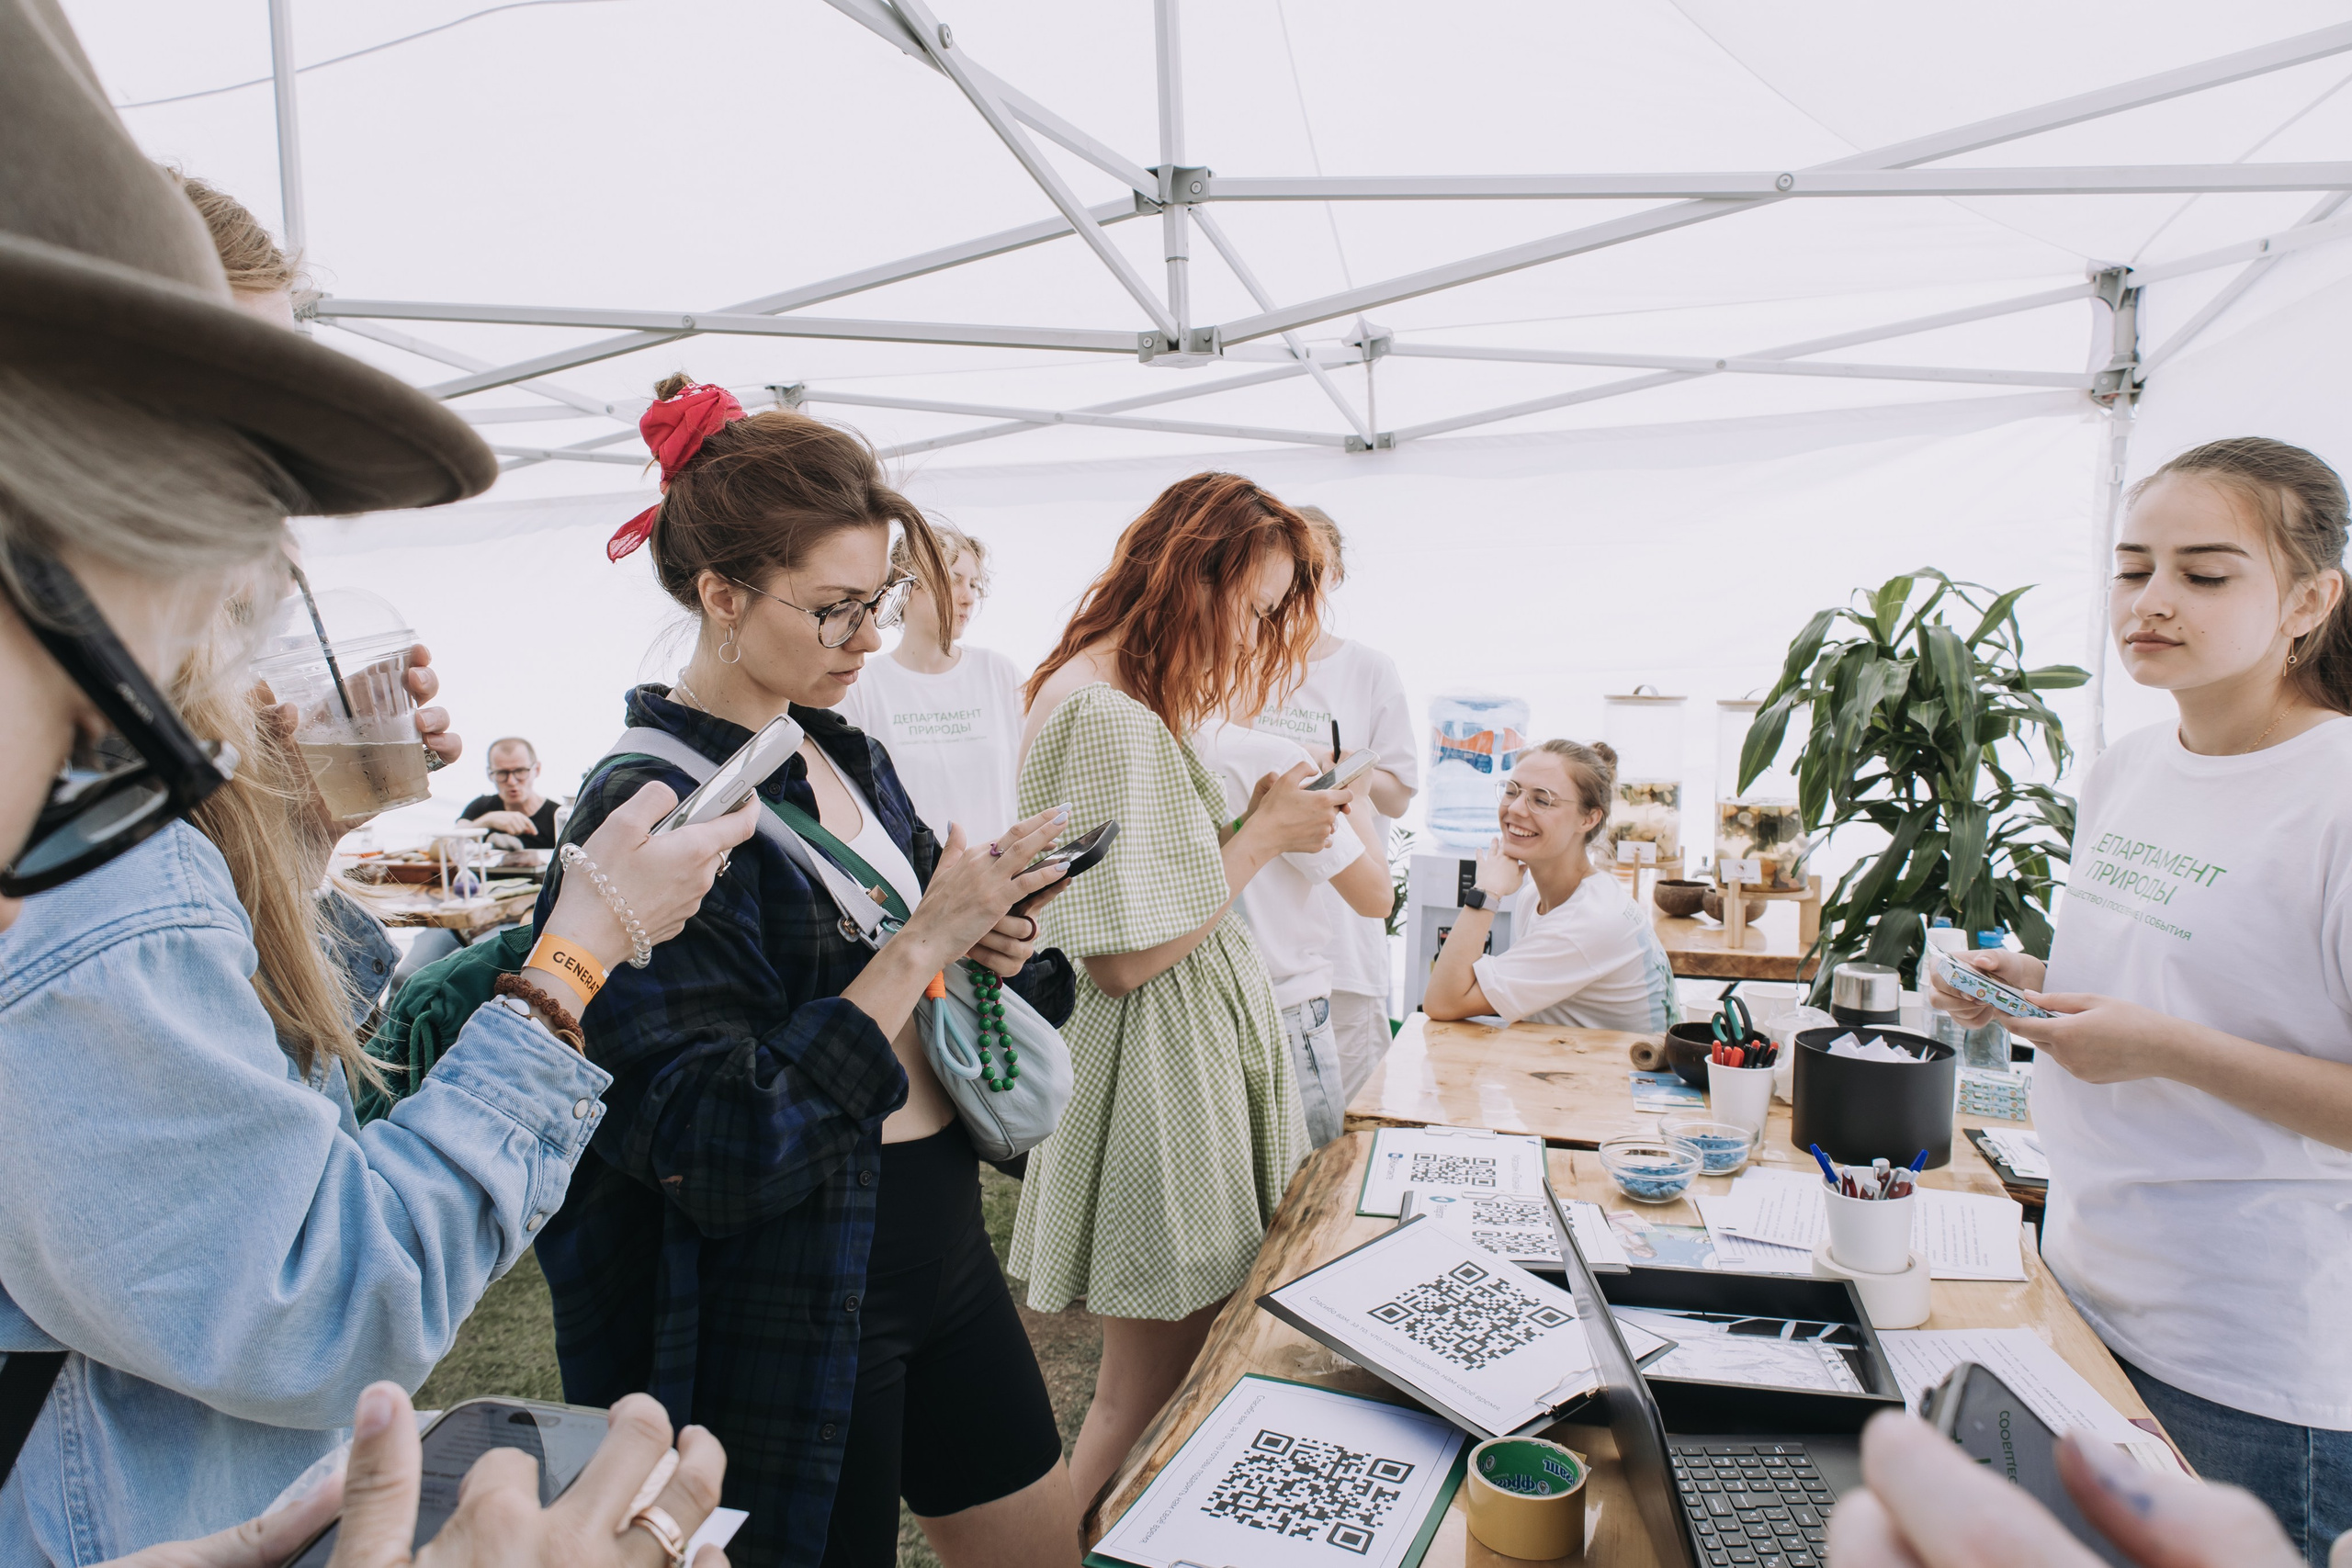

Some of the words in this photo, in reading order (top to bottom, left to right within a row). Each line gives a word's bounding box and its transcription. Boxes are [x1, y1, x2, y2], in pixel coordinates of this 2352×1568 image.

[893, 708, 982, 726] ДЕПАРТАМЕНТ
[909, 722, 971, 736] ПРИРОДЫ
[2085, 859, 2178, 905] ПРИРОДЫ
[2144, 915, 2192, 942] СОБЫТИЯ
[1309, 1295, 1337, 1314] Спасибо
[1370, 1333, 1383, 1342] что
[1382, 1339, 1408, 1356] готовы
[1407, 1354, 1441, 1376] подарить
[1441, 1374, 1457, 1385] нам
[1243, 1394, 1265, 1416] Спасибо
[1216, 1440, 1227, 1451] что
[1201, 1450, 1219, 1470] готовы
[1178, 1469, 1204, 1496] подарить
[1169, 1496, 1182, 1509] нам
